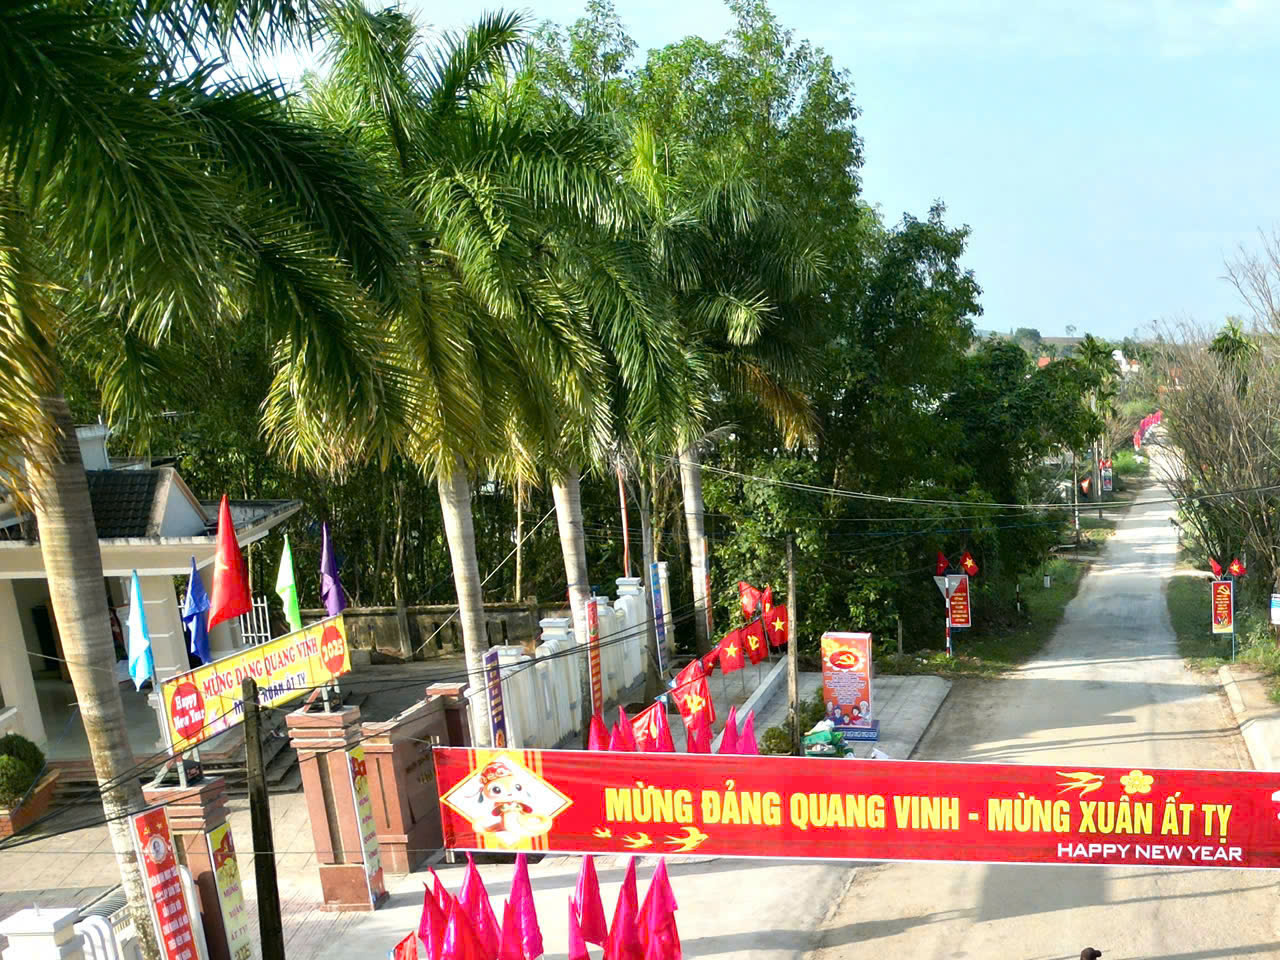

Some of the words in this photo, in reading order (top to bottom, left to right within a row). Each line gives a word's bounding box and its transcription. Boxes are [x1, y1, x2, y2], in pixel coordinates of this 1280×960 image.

[264, 646, 295, 677] QUANG
[605, 780, 693, 823] MỪNG
[701, 779, 782, 825] ĐẢNG
[790, 792, 886, 830] QUANG
[893, 795, 959, 830] VINH
[988, 792, 1070, 833] MỪNG
[1079, 795, 1152, 835] XUÂN
[1161, 791, 1194, 836] ẤT
[1201, 804, 1233, 843] TỴ
[1057, 842, 1131, 859] HAPPY
[1135, 844, 1184, 860] NEW
[1187, 845, 1243, 862] YEAR
